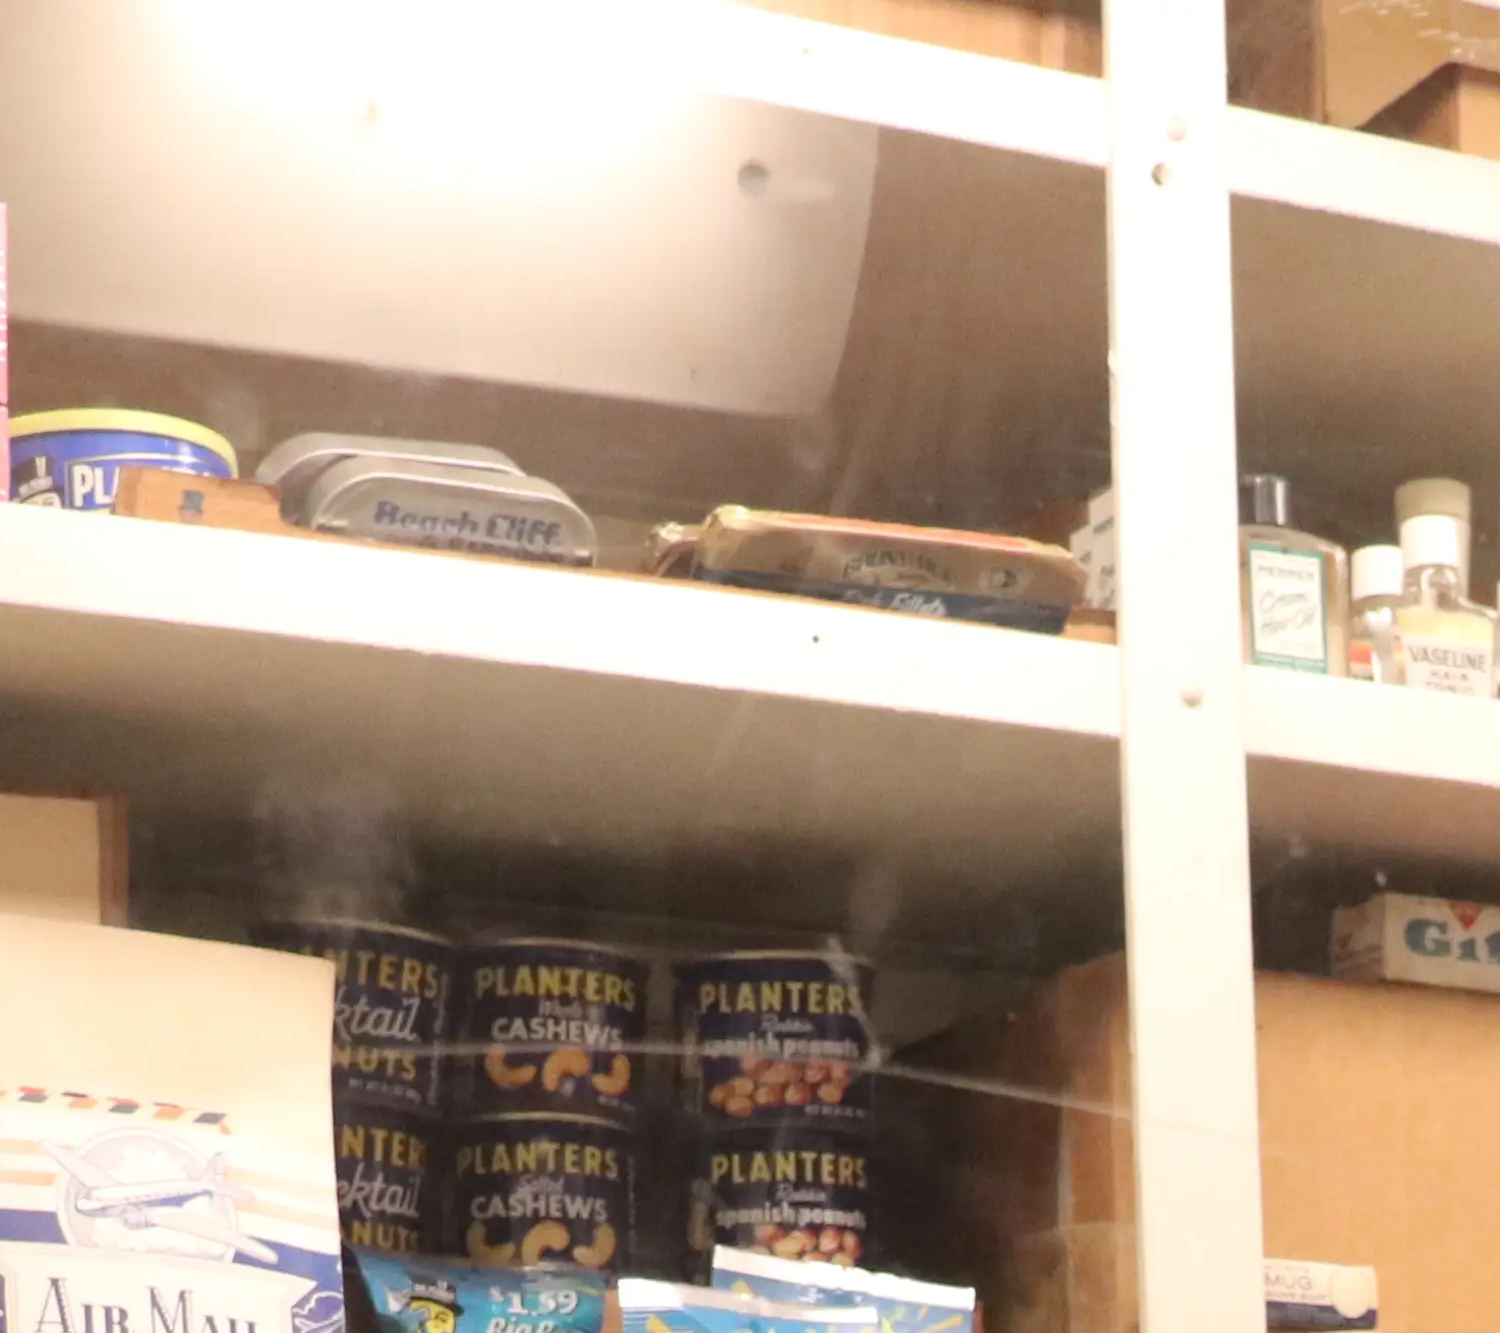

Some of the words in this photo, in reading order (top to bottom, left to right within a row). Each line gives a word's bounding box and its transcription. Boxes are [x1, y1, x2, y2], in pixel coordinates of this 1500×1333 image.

[1407, 645, 1487, 673] VASELINE
[474, 964, 635, 1012] PLANTERS
[701, 980, 860, 1015] PLANTERS
[490, 1016, 624, 1050] CASHEWS
[456, 1141, 619, 1182] PLANTERS
[711, 1149, 866, 1188] PLANTERS
[469, 1193, 607, 1222] CASHEWS
